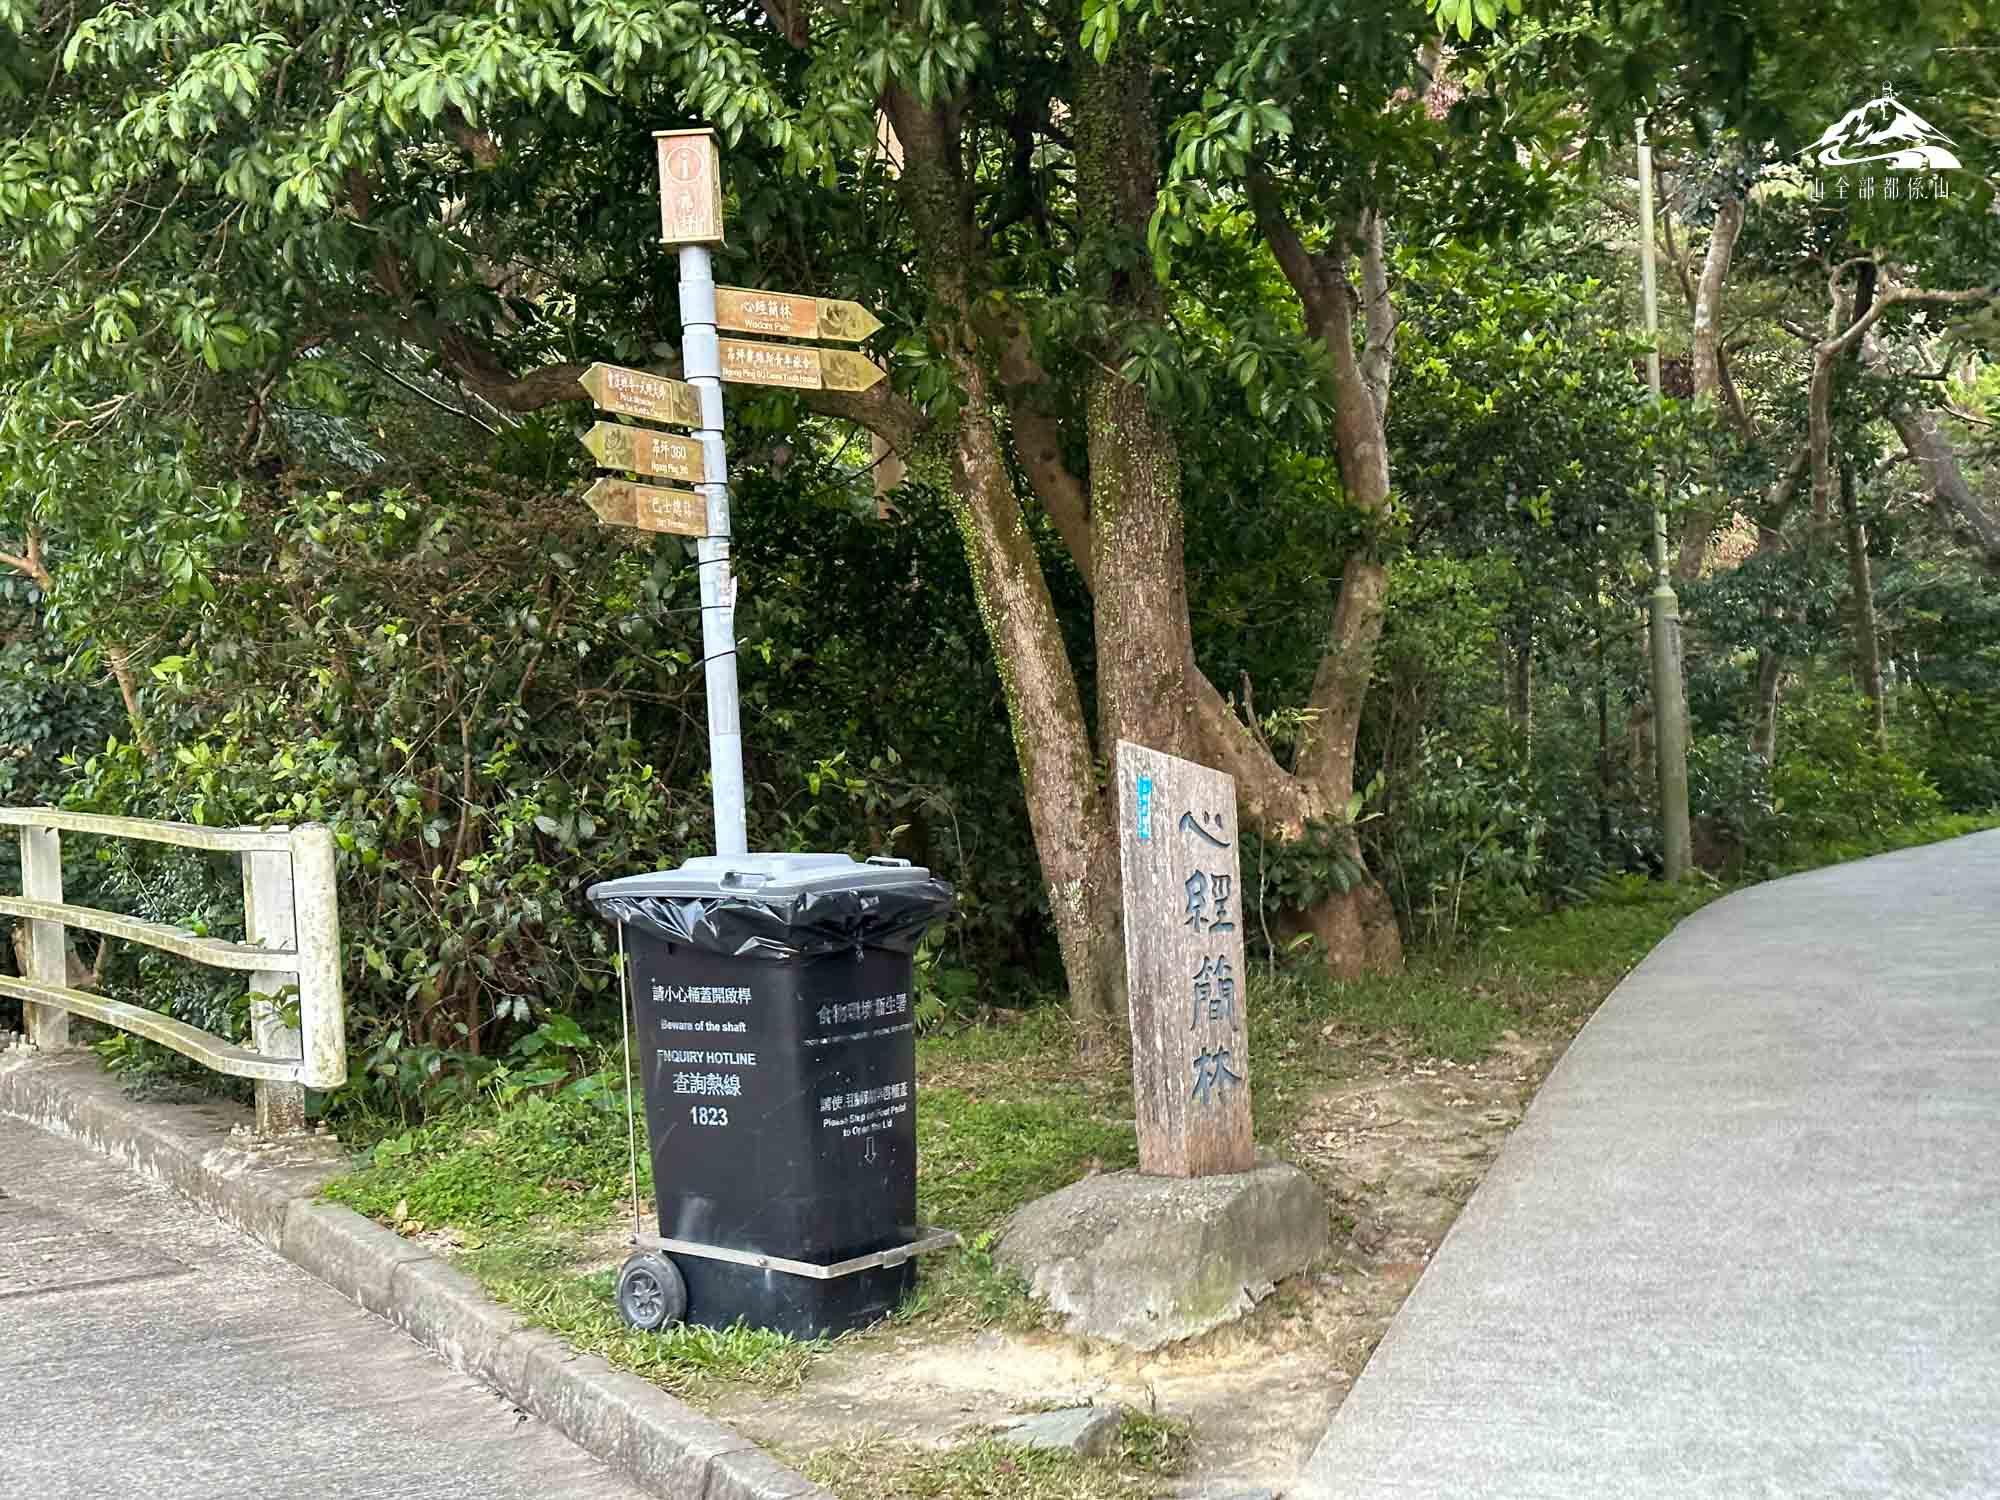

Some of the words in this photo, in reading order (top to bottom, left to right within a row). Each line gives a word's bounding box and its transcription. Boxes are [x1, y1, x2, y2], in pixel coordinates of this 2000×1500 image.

[1178, 809, 1243, 1105] 心經簡林
[661, 1019, 693, 1031] Beware
[694, 1021, 704, 1031] of
[706, 1021, 721, 1032] the
[722, 1021, 747, 1033] shaft
[706, 1051, 758, 1066] HOTLINE
[672, 1072, 742, 1097] 查詢熱線
[690, 1106, 729, 1127] 1823
[849, 1114, 866, 1125] Step
[843, 1128, 852, 1137] to
